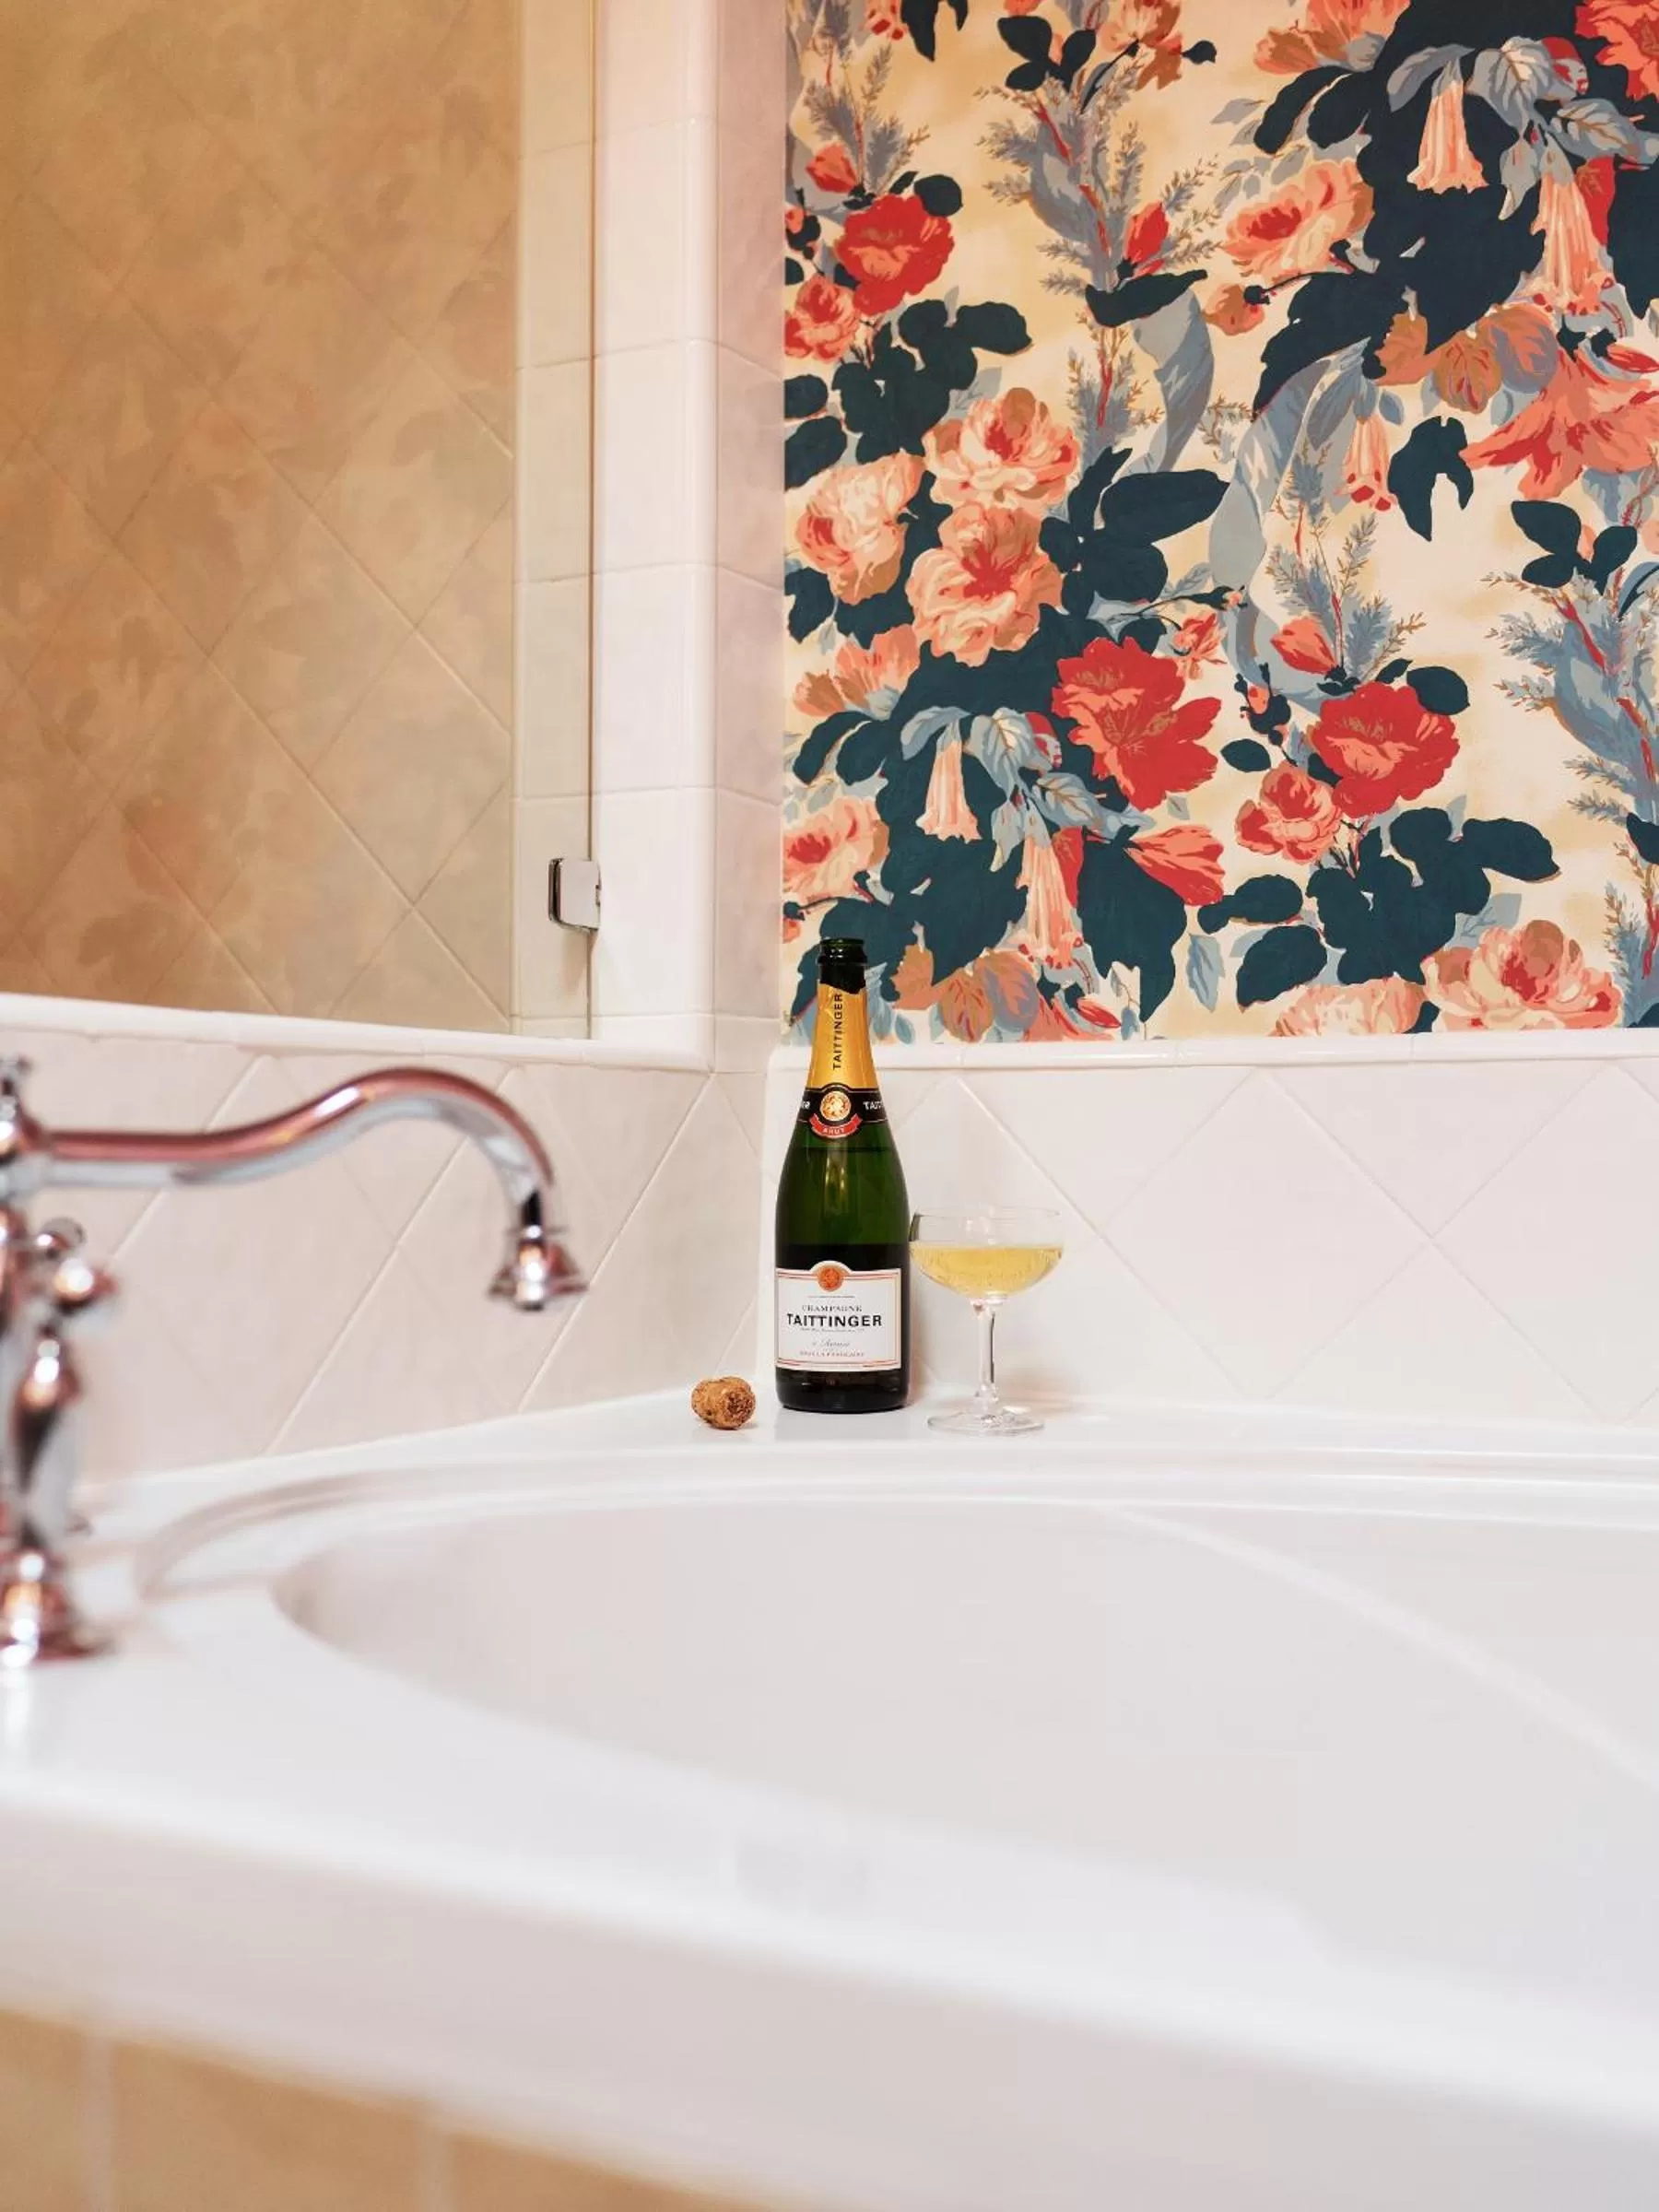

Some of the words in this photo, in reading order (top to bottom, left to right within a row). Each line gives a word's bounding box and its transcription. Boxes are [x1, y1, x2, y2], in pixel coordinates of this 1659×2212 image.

[833, 994, 843, 1070] TAITTINGER
[802, 1304, 863, 1312] CHAMPAGNE
[787, 1313, 882, 1327] TAITTINGER
